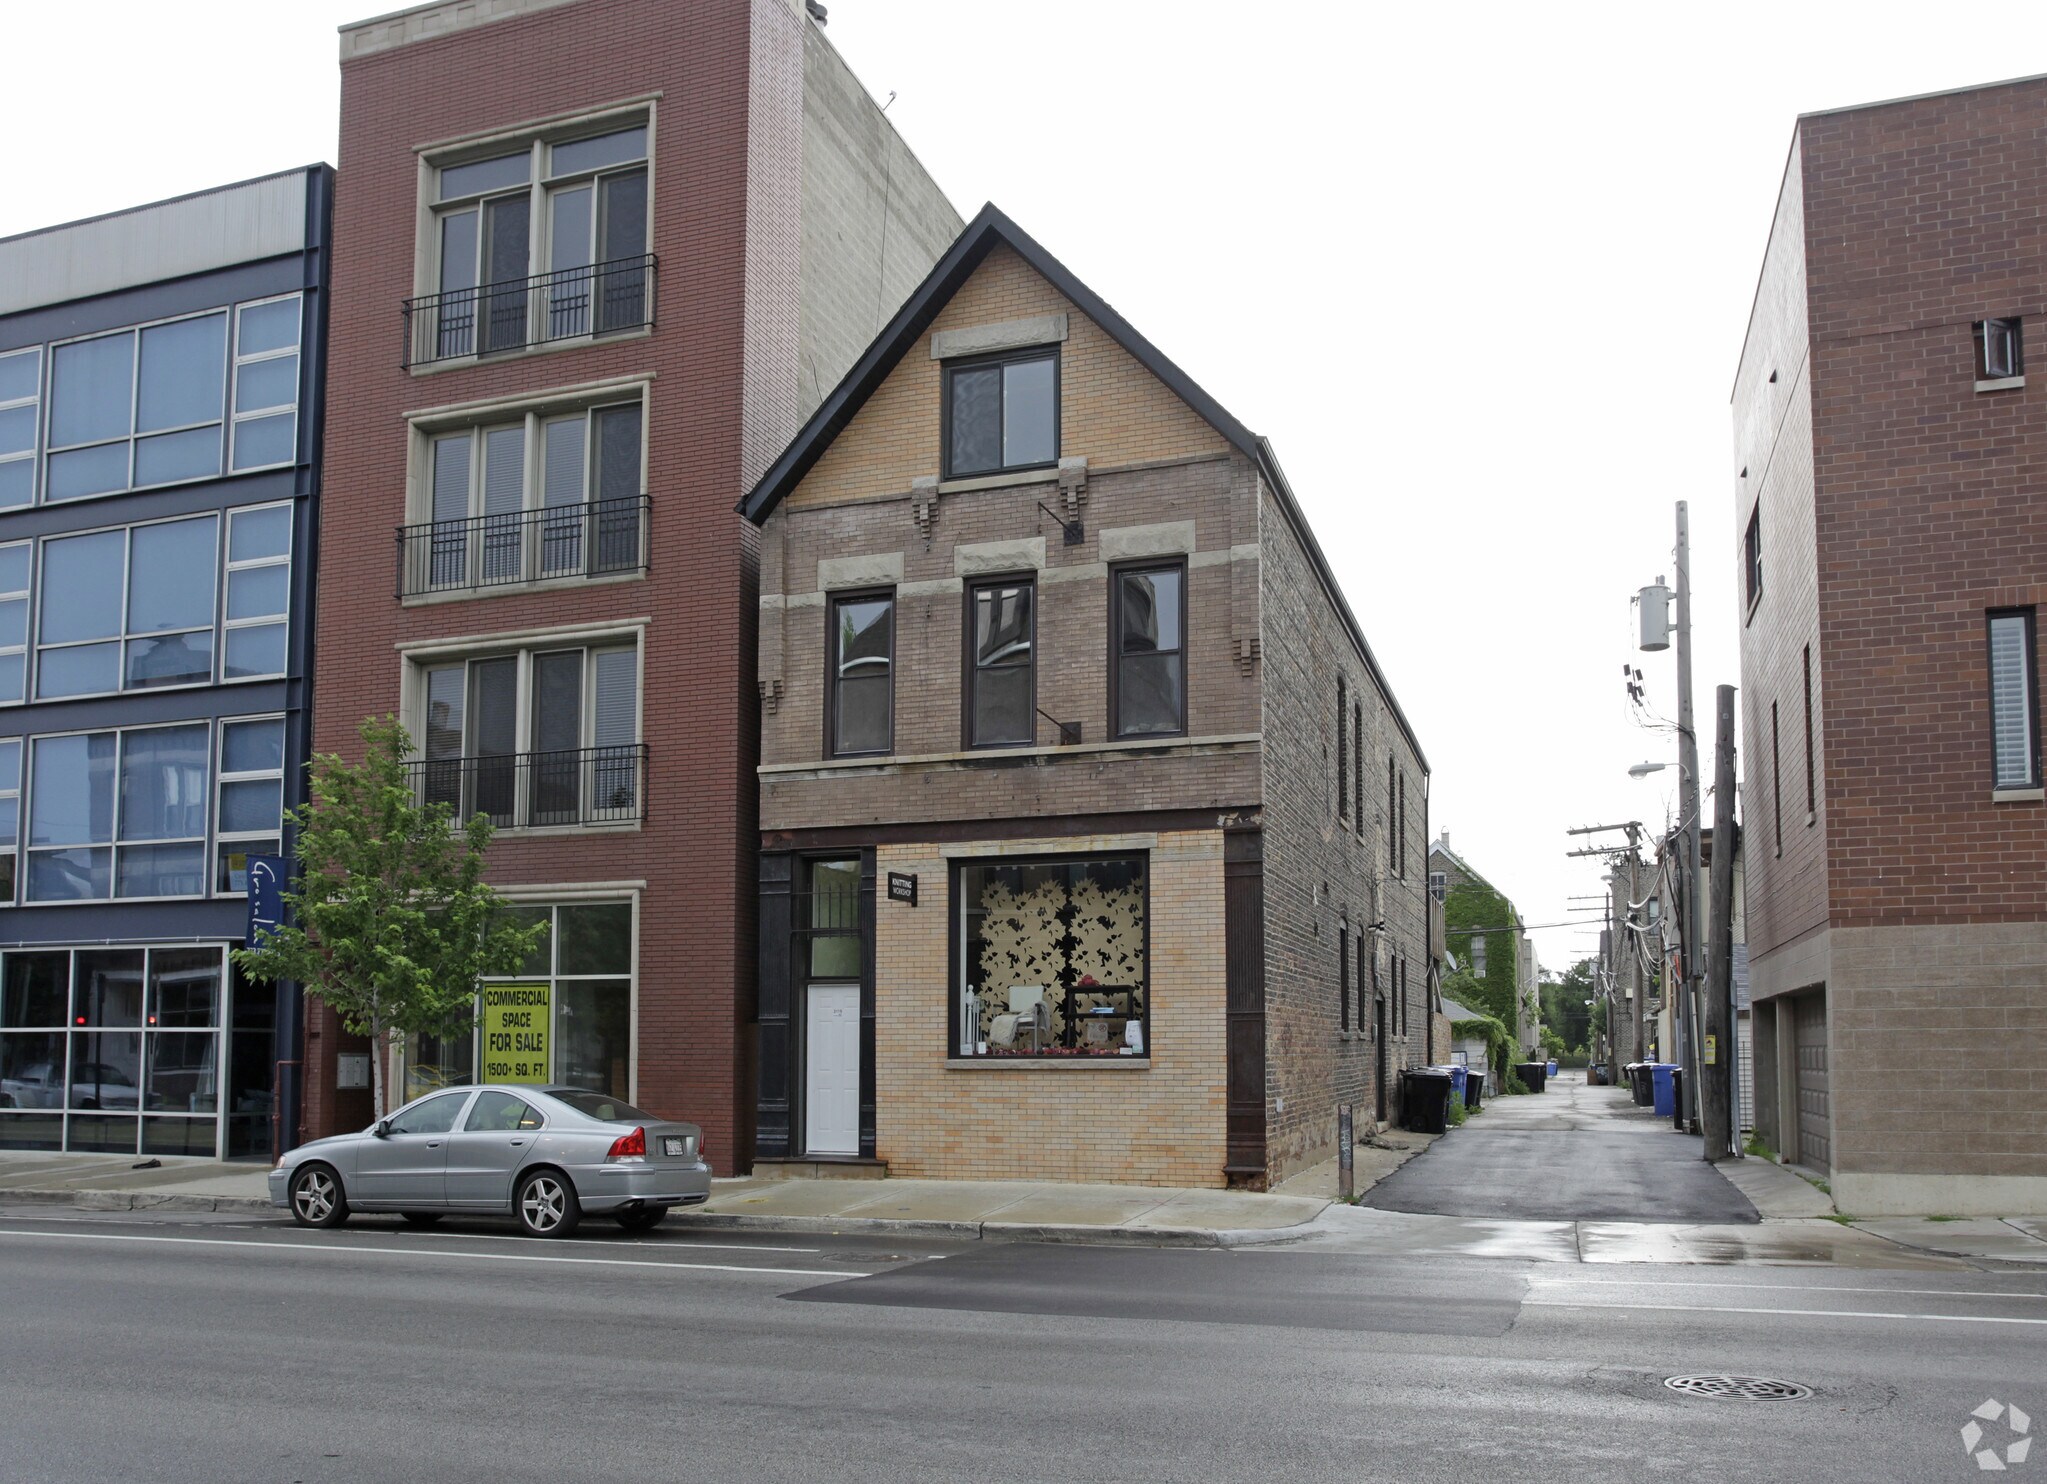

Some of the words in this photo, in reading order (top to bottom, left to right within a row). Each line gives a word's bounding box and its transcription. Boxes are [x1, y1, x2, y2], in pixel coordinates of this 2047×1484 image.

[892, 878, 912, 888] KNITTING
[487, 991, 547, 1006] COMMERCIAL
[502, 1012, 531, 1027] SPACE
[490, 1033, 511, 1051] FOR
[516, 1033, 543, 1051] SALE
[487, 1063, 512, 1076] 1500+
[515, 1063, 530, 1076] SQ.
[533, 1063, 546, 1076] FT.
